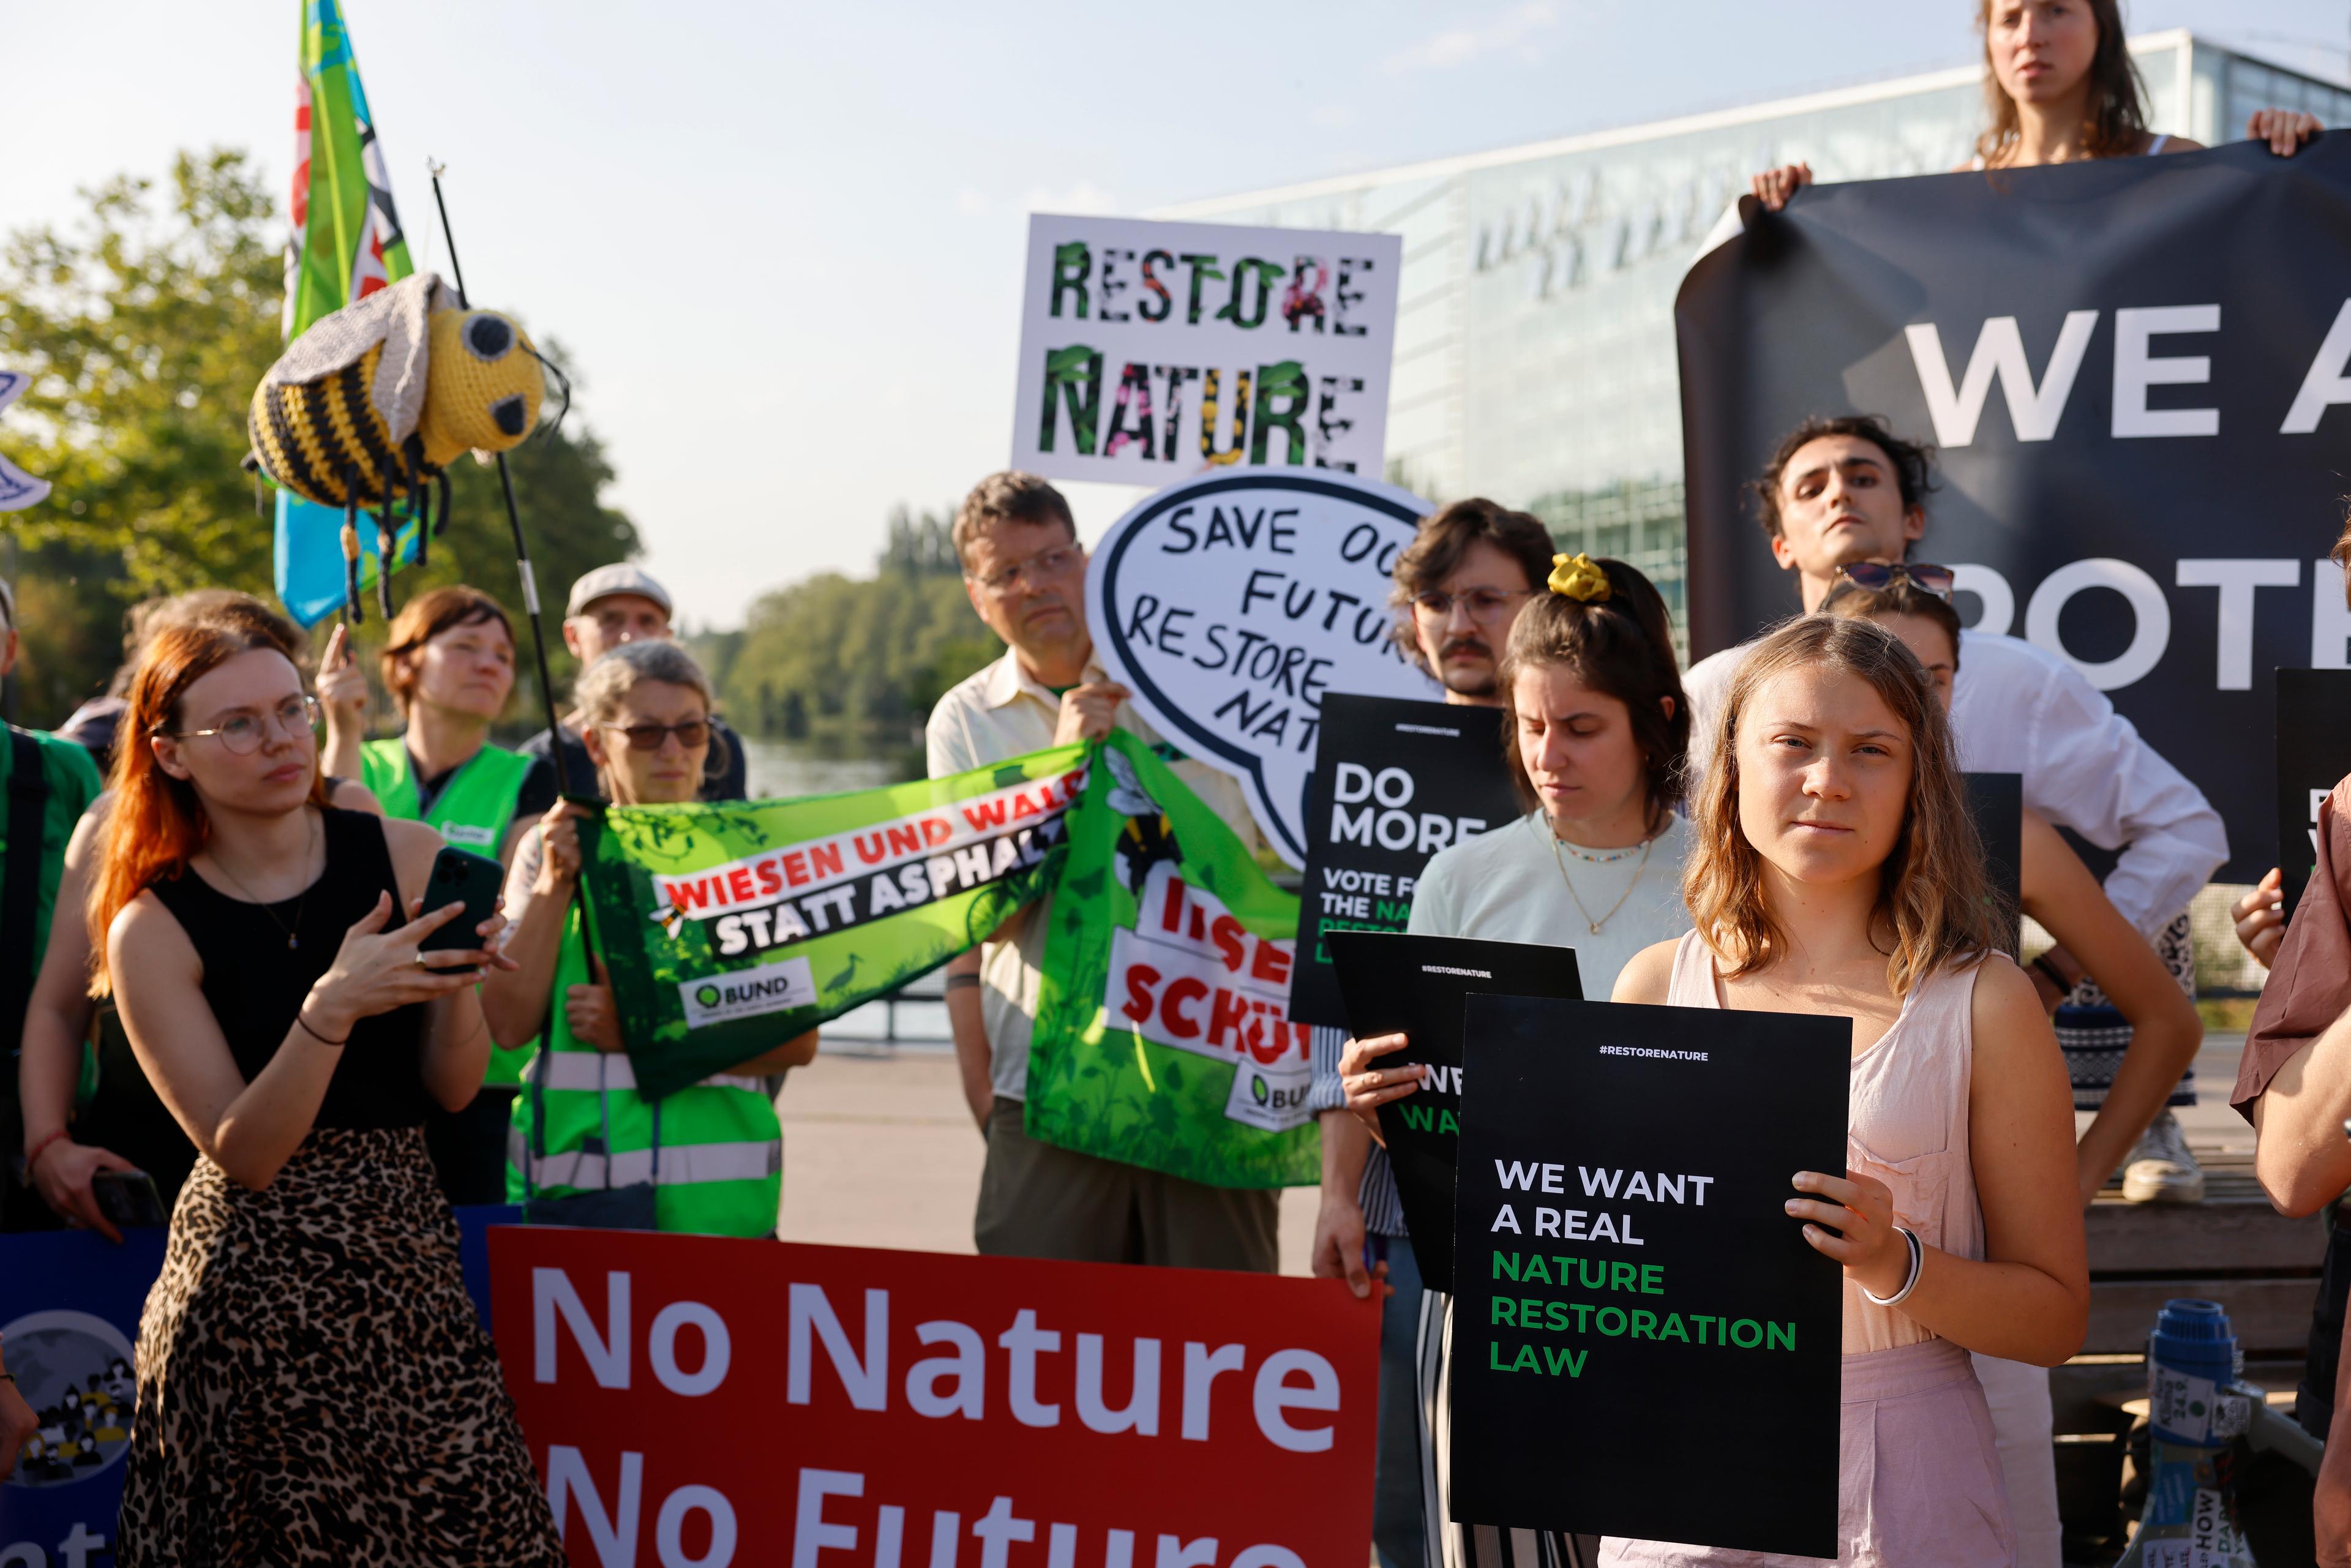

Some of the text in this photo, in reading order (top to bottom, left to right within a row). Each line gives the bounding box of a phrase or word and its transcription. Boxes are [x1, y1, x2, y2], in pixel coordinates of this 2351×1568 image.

[1048, 241, 1374, 337] RESTORE
[1904, 303, 2222, 449] WE
[1038, 344, 1365, 474] NATURE
[1161, 506, 1299, 554] SAVE
[1125, 593, 1335, 705] RESTORE
[1333, 762, 1415, 809] DO
[664, 842, 844, 910] WIESEN
[853, 818, 953, 865] UND
[715, 818, 1062, 956] STATT ASPHALT
[1322, 866, 1392, 896] VOTE
[1320, 892, 1370, 918] THE
[725, 977, 789, 1005] BUND
[1421, 964, 1492, 980] #RESTORENATURE
[1599, 1045, 1708, 1062] #RESTORENATURE
[1397, 1103, 1460, 1136] WA
[1494, 1159, 1714, 1206] WE WANT
[1490, 1204, 1644, 1245] A REAL
[1493, 1250, 1665, 1295] NATURE
[1491, 1296, 1796, 1351] RESTORATION
[531, 1267, 1341, 1453] No Nature
[1490, 1341, 1588, 1378] LAW
[546, 1445, 738, 1568] No
[2195, 1494, 2214, 1551] HOW
